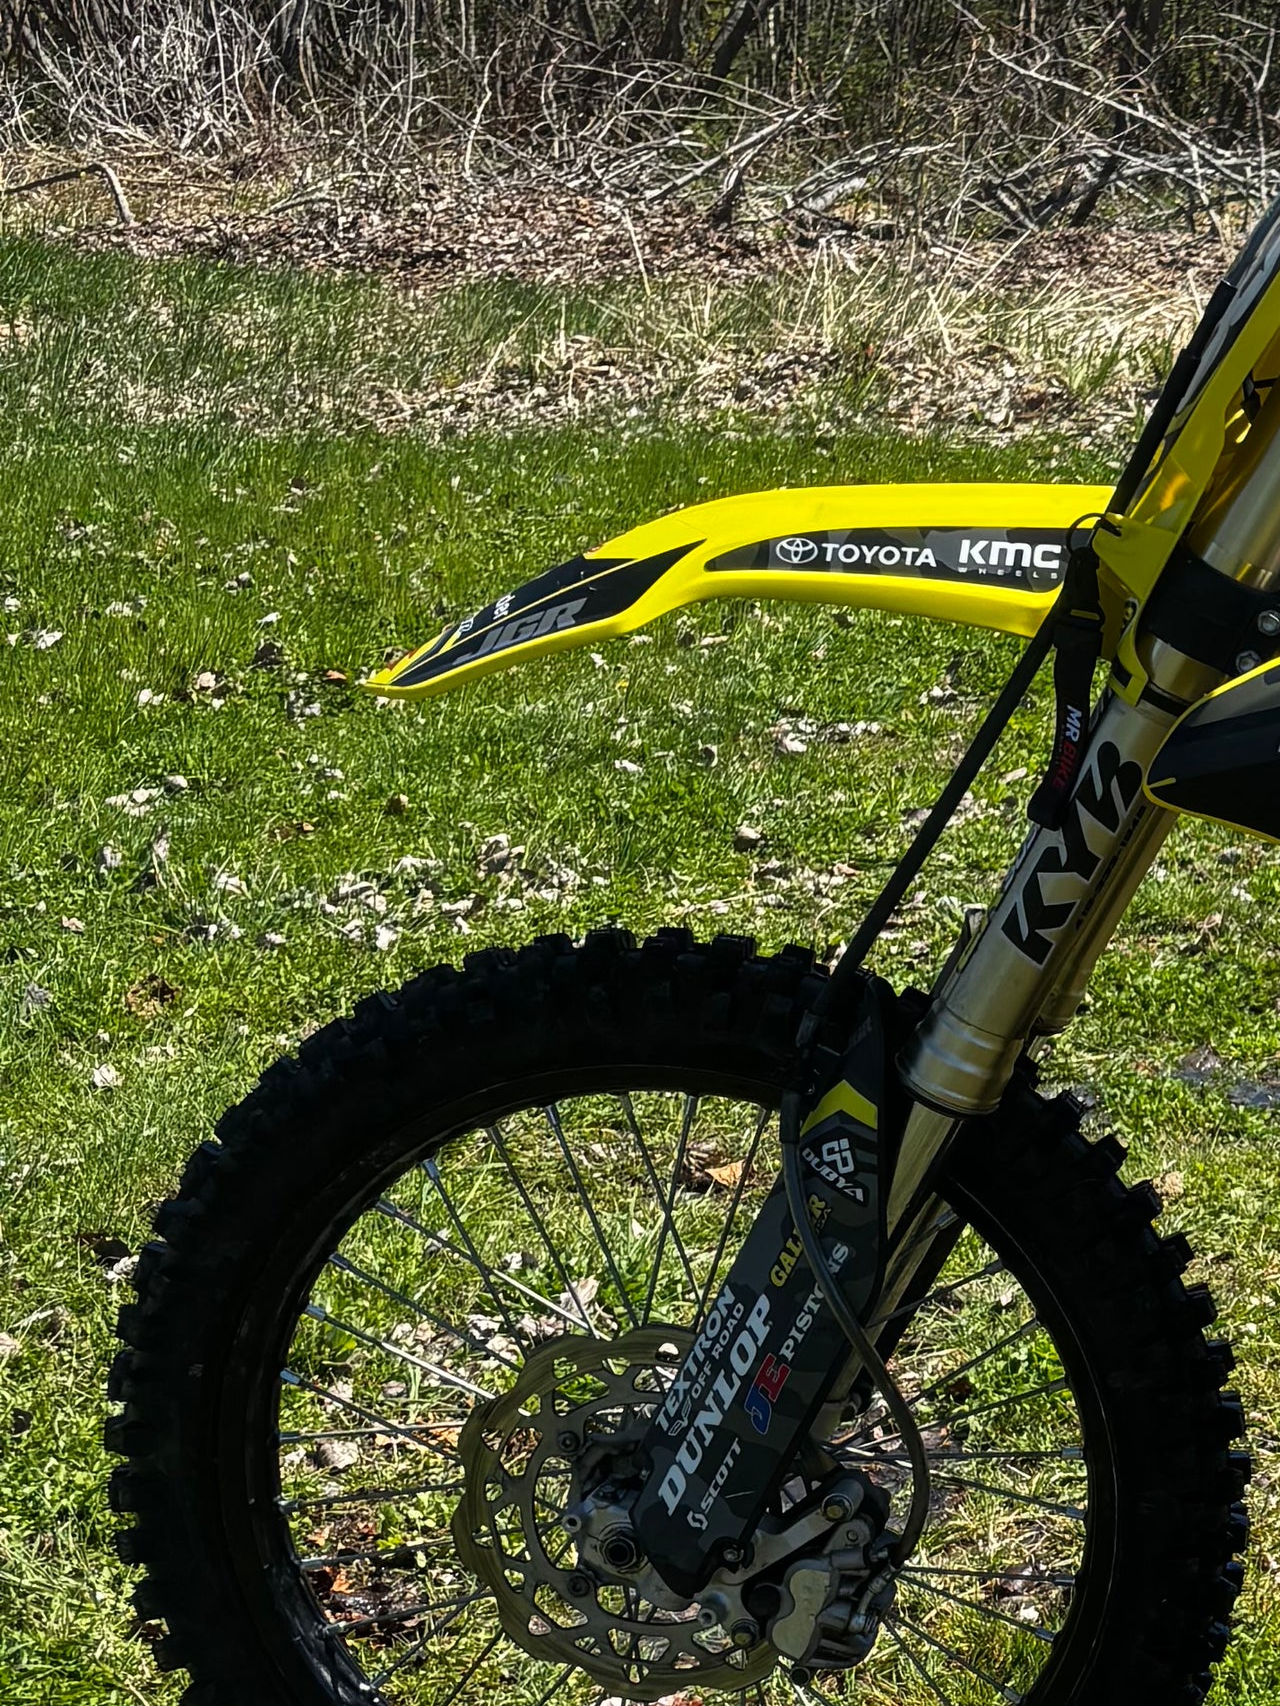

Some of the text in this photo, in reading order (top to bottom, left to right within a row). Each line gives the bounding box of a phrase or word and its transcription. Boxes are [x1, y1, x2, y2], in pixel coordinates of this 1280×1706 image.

[821, 542, 937, 568] TOYOTA
[453, 596, 588, 665] JGR
[1066, 704, 1083, 743] MR
[1001, 740, 1143, 966] KYB
[801, 1147, 865, 1205] DUBYA
[770, 1194, 826, 1288] GALR
[655, 1284, 736, 1432] TEXTRON
[691, 1302, 745, 1399] OFF ROAD
[658, 1293, 771, 1517] DUNLOP
[744, 1352, 791, 1435] JE
[701, 1437, 742, 1515] SCOTT
